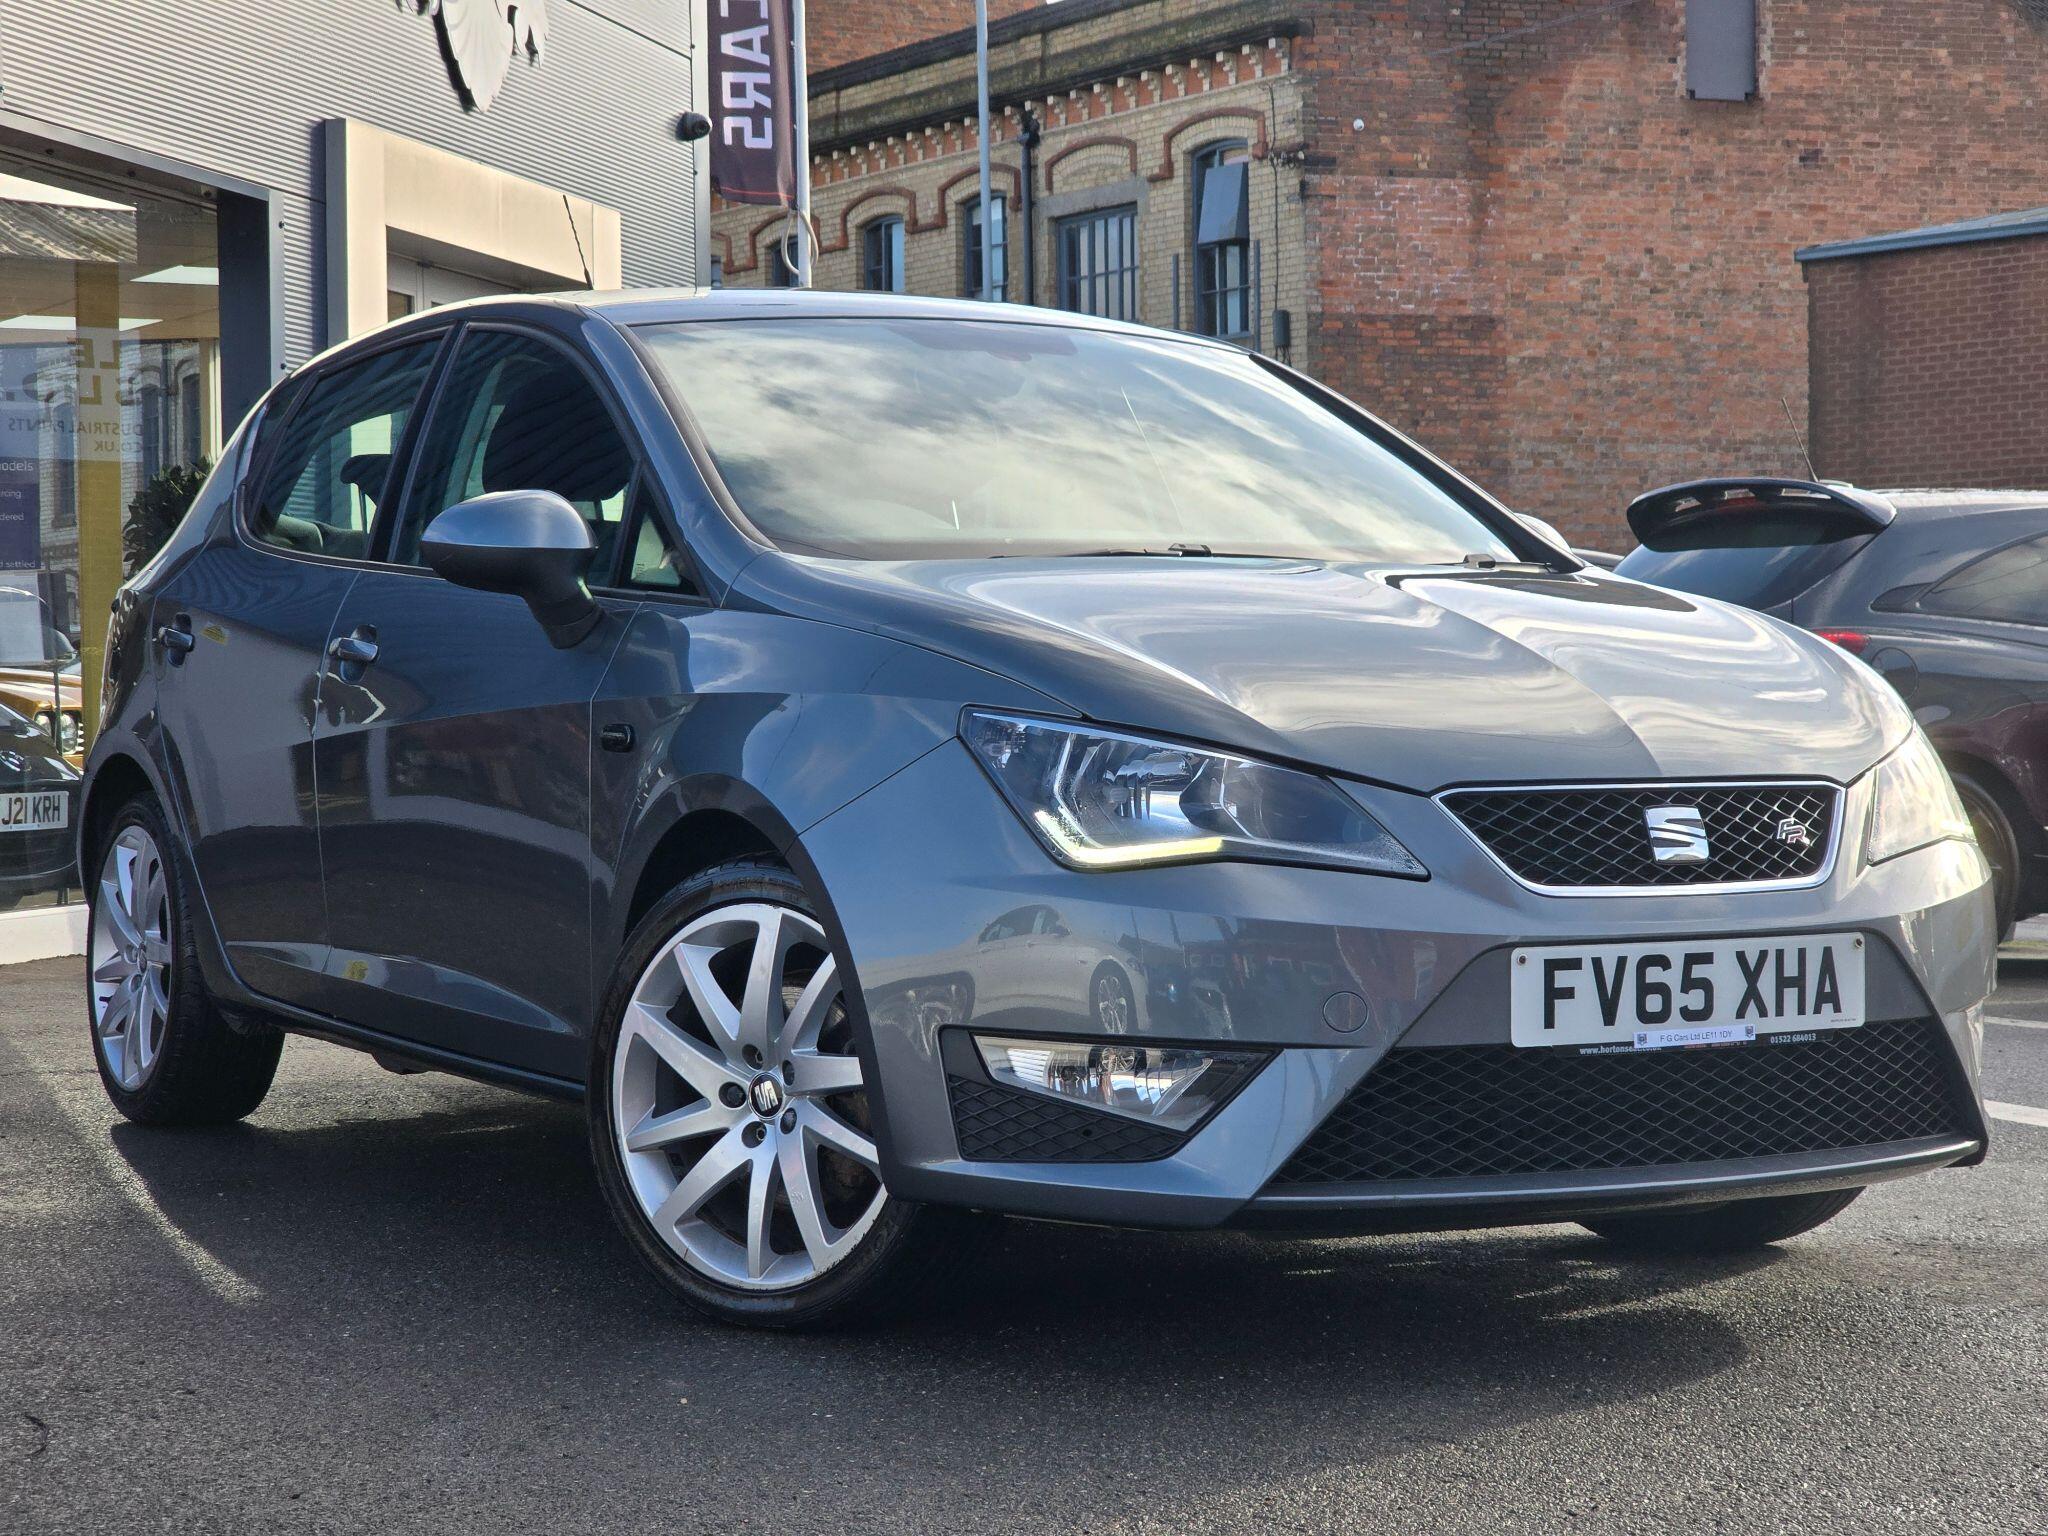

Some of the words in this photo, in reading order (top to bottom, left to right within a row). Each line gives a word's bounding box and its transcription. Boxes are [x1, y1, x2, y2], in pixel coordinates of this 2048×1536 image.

[0, 461, 34, 471] odels
[32, 795, 60, 823] KRH
[1543, 952, 1714, 1030] FV65
[1735, 946, 1842, 1020] XHA
